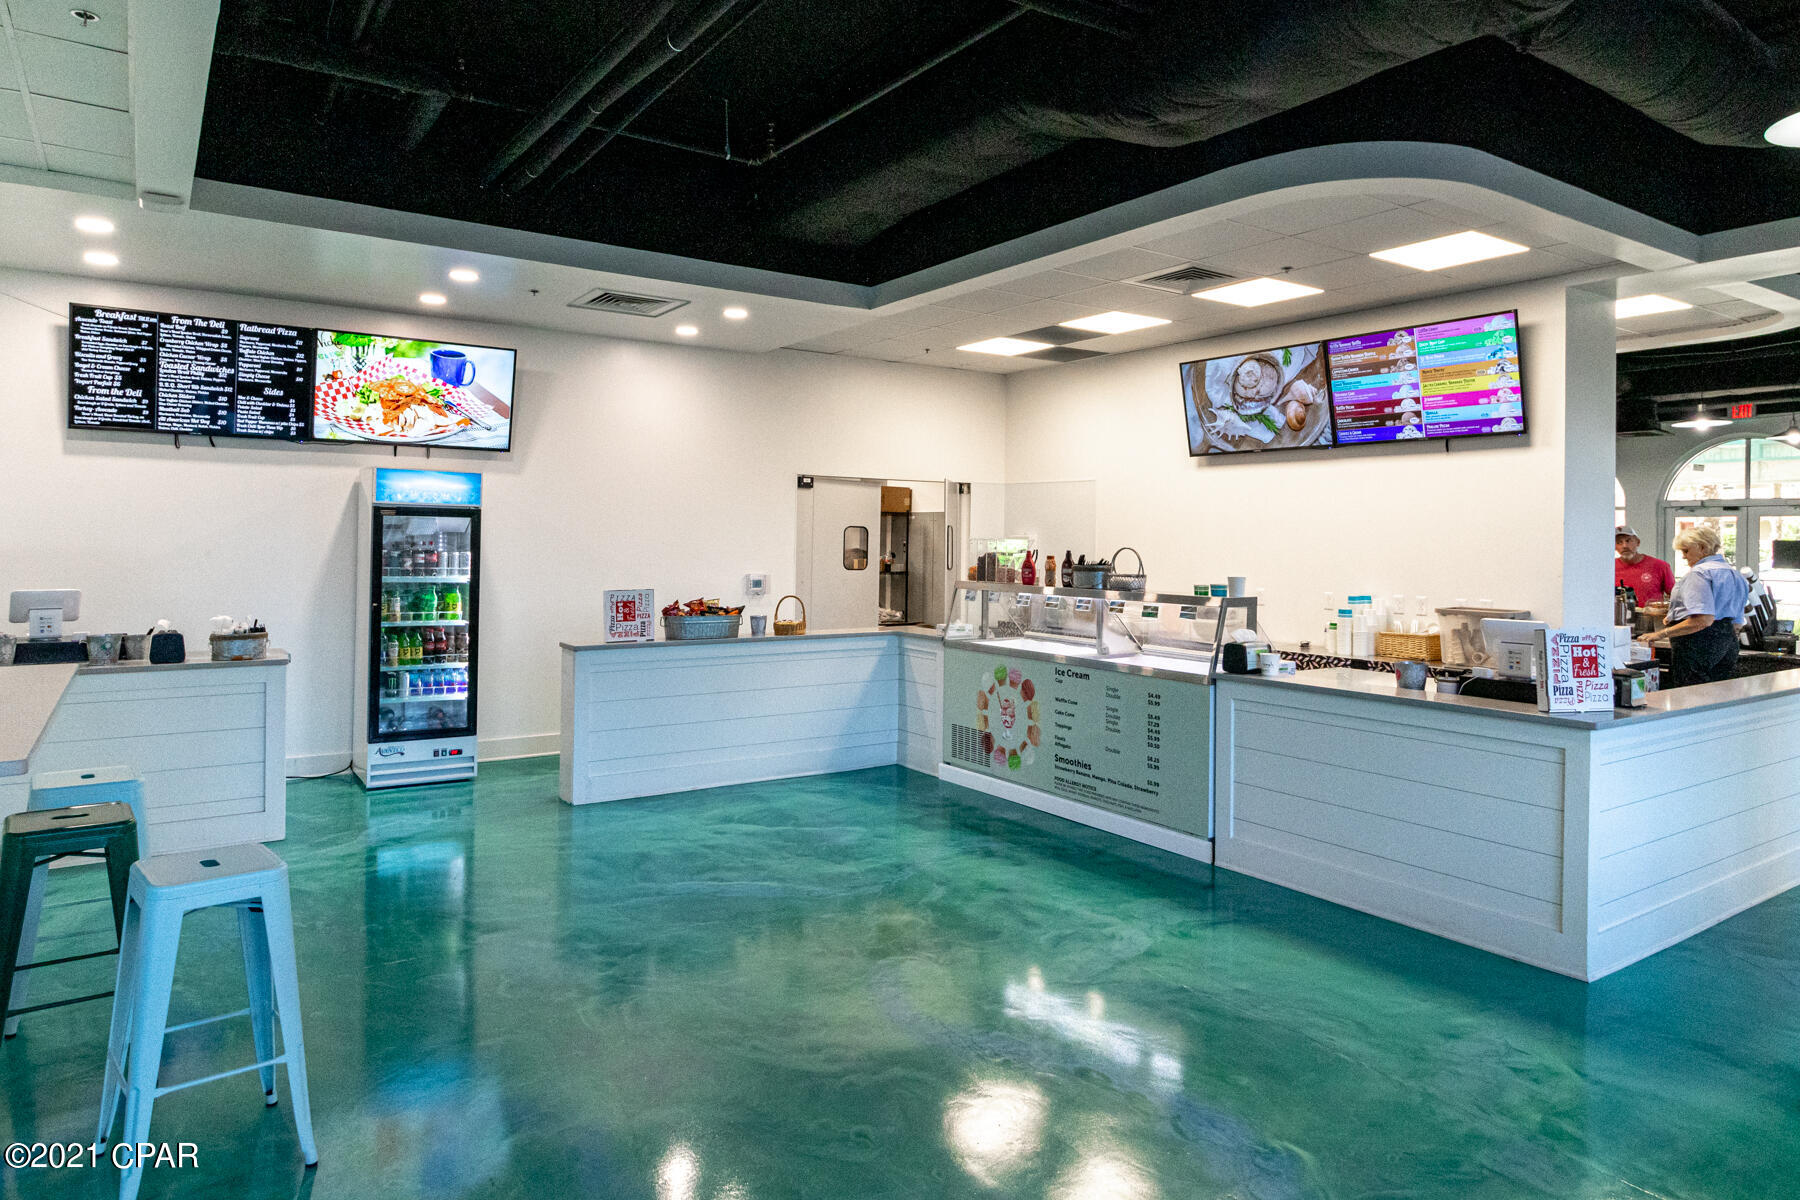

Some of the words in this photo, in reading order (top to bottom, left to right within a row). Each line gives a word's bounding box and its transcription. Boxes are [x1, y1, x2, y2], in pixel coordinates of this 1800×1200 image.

[94, 309, 137, 322] Breakfast
[171, 316, 192, 326] From
[194, 318, 208, 326] The
[209, 320, 225, 328] Deli
[240, 324, 276, 334] Flatbread
[277, 328, 297, 336] Pizza
[159, 361, 189, 370] Toasted
[190, 364, 234, 374] Sandwiches
[87, 386, 110, 395] From
[111, 387, 124, 396] the
[125, 388, 142, 397] Deli
[263, 387, 284, 396] Sides
[1732, 403, 1752, 419] EXIT
[616, 623, 638, 632] Pizza
[1560, 633, 1580, 643] Pizza
[1573, 646, 1596, 657] Hot
[1597, 635, 1606, 678] PIZZA
[1560, 645, 1569, 683] Pizza
[1582, 658, 1589, 668] &
[1055, 667, 1065, 677] Ice
[1066, 669, 1090, 680] Cream
[1573, 664, 1597, 677] Fresh
[1553, 686, 1573, 696] Pizza
[1585, 680, 1608, 690] Pizza
[1585, 691, 1608, 702] Pizza
[1055, 754, 1091, 770] Smoothies
[1055, 764, 1075, 774] Strawberry
[1076, 770, 1091, 778] Banana,
[1092, 774, 1106, 782] Mango,
[1134, 785, 1159, 797] Strawberry
